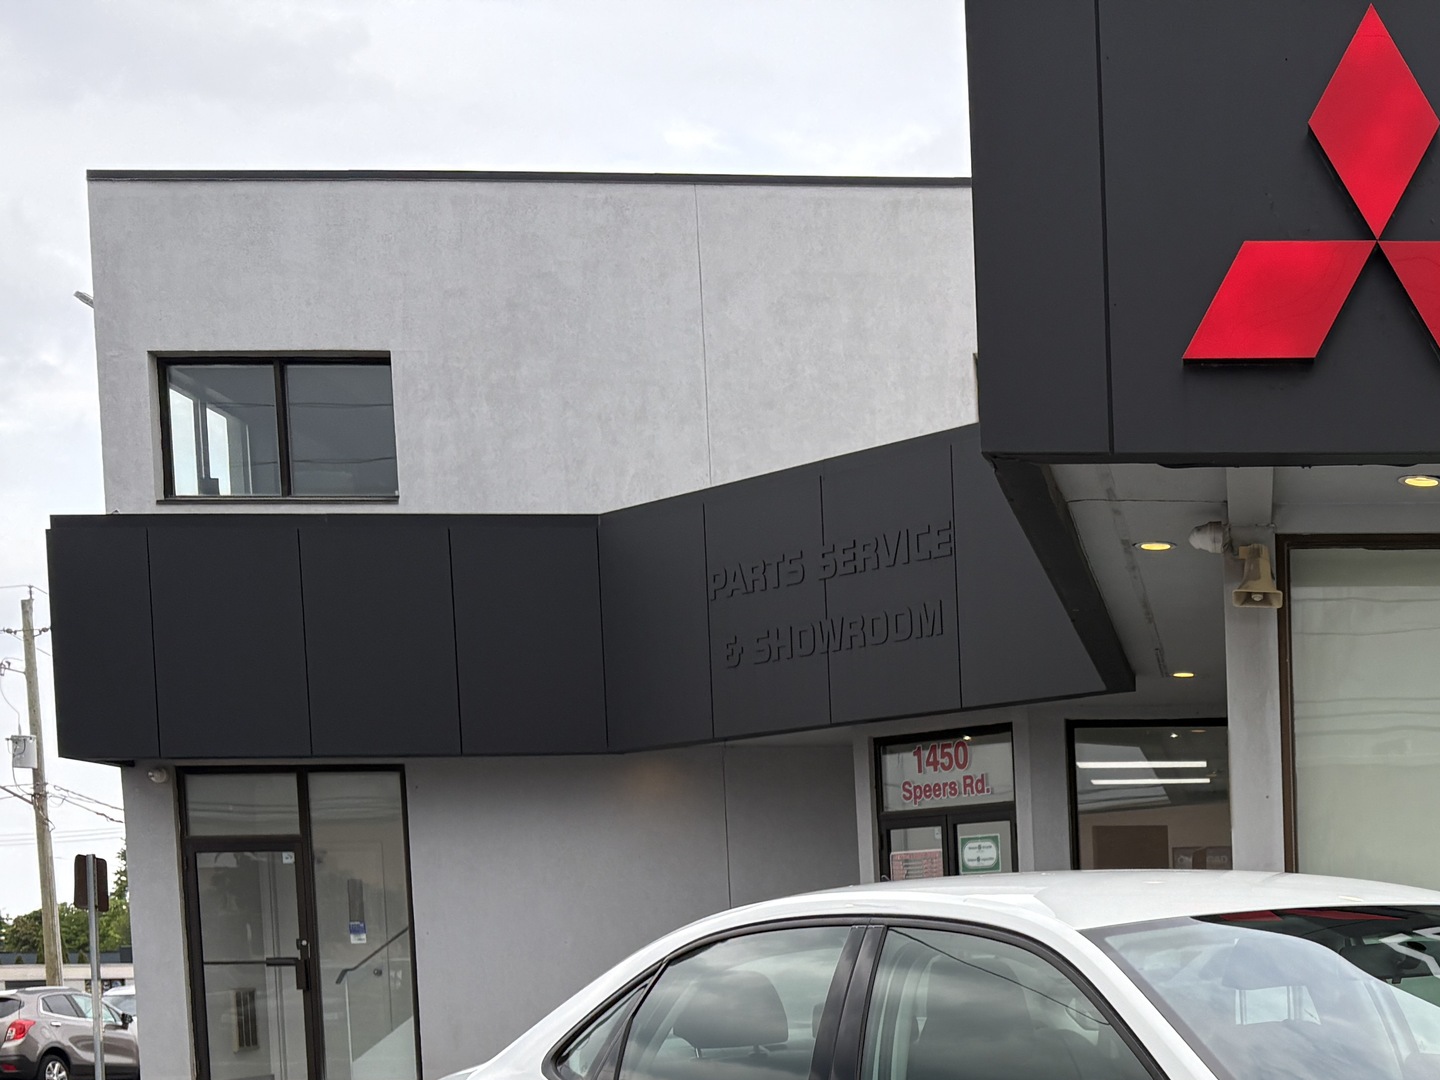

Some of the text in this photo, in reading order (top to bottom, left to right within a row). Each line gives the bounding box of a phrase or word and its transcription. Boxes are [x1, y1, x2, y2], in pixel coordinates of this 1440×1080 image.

[710, 521, 954, 602] PARTS SERVICE
[726, 600, 945, 669] & SHOWROOM
[912, 740, 969, 775] 1450
[901, 773, 992, 806] Speers Rd.
